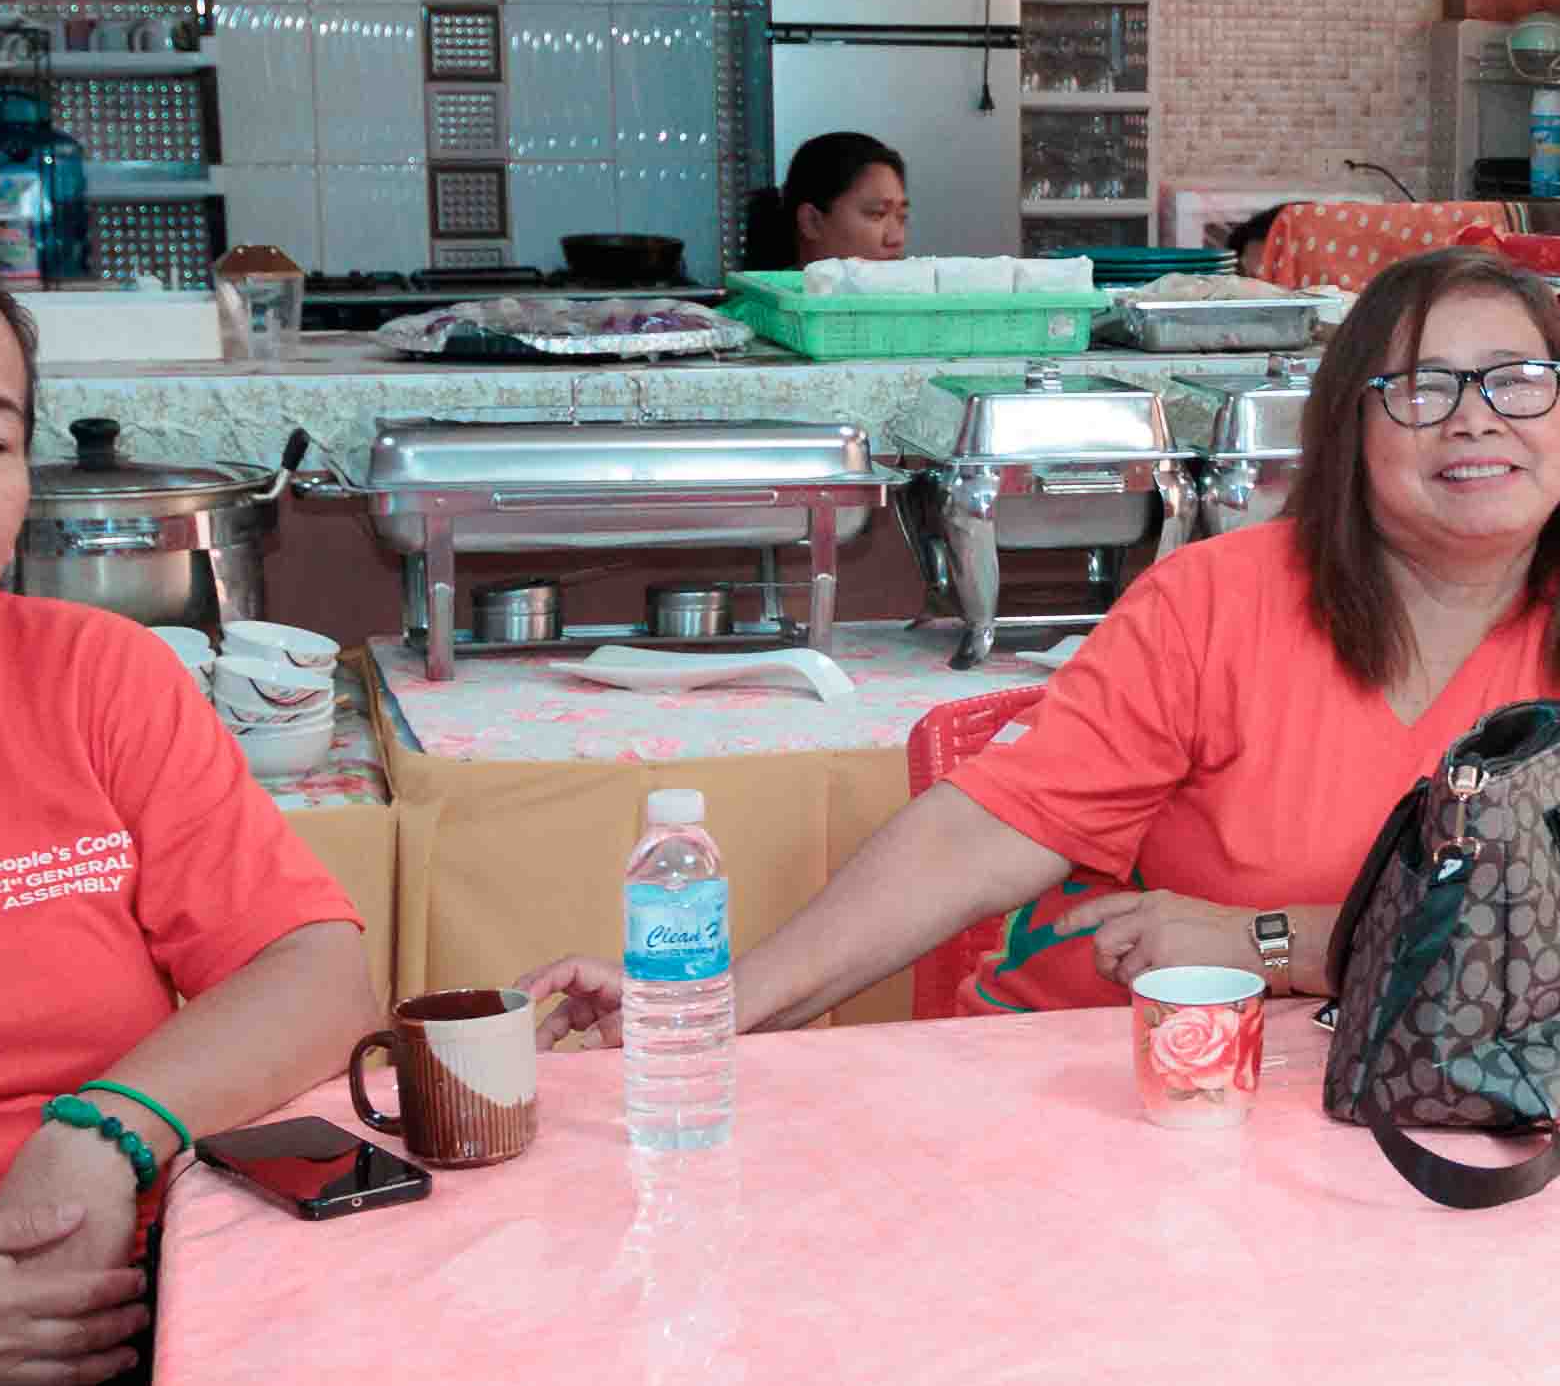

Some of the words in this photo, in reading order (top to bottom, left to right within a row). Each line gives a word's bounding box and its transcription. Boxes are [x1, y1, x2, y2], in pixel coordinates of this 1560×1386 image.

[25, 853, 134, 888] GENERAL
[3, 875, 126, 910] ASSEMBLY
[646, 924, 700, 948] Clean
